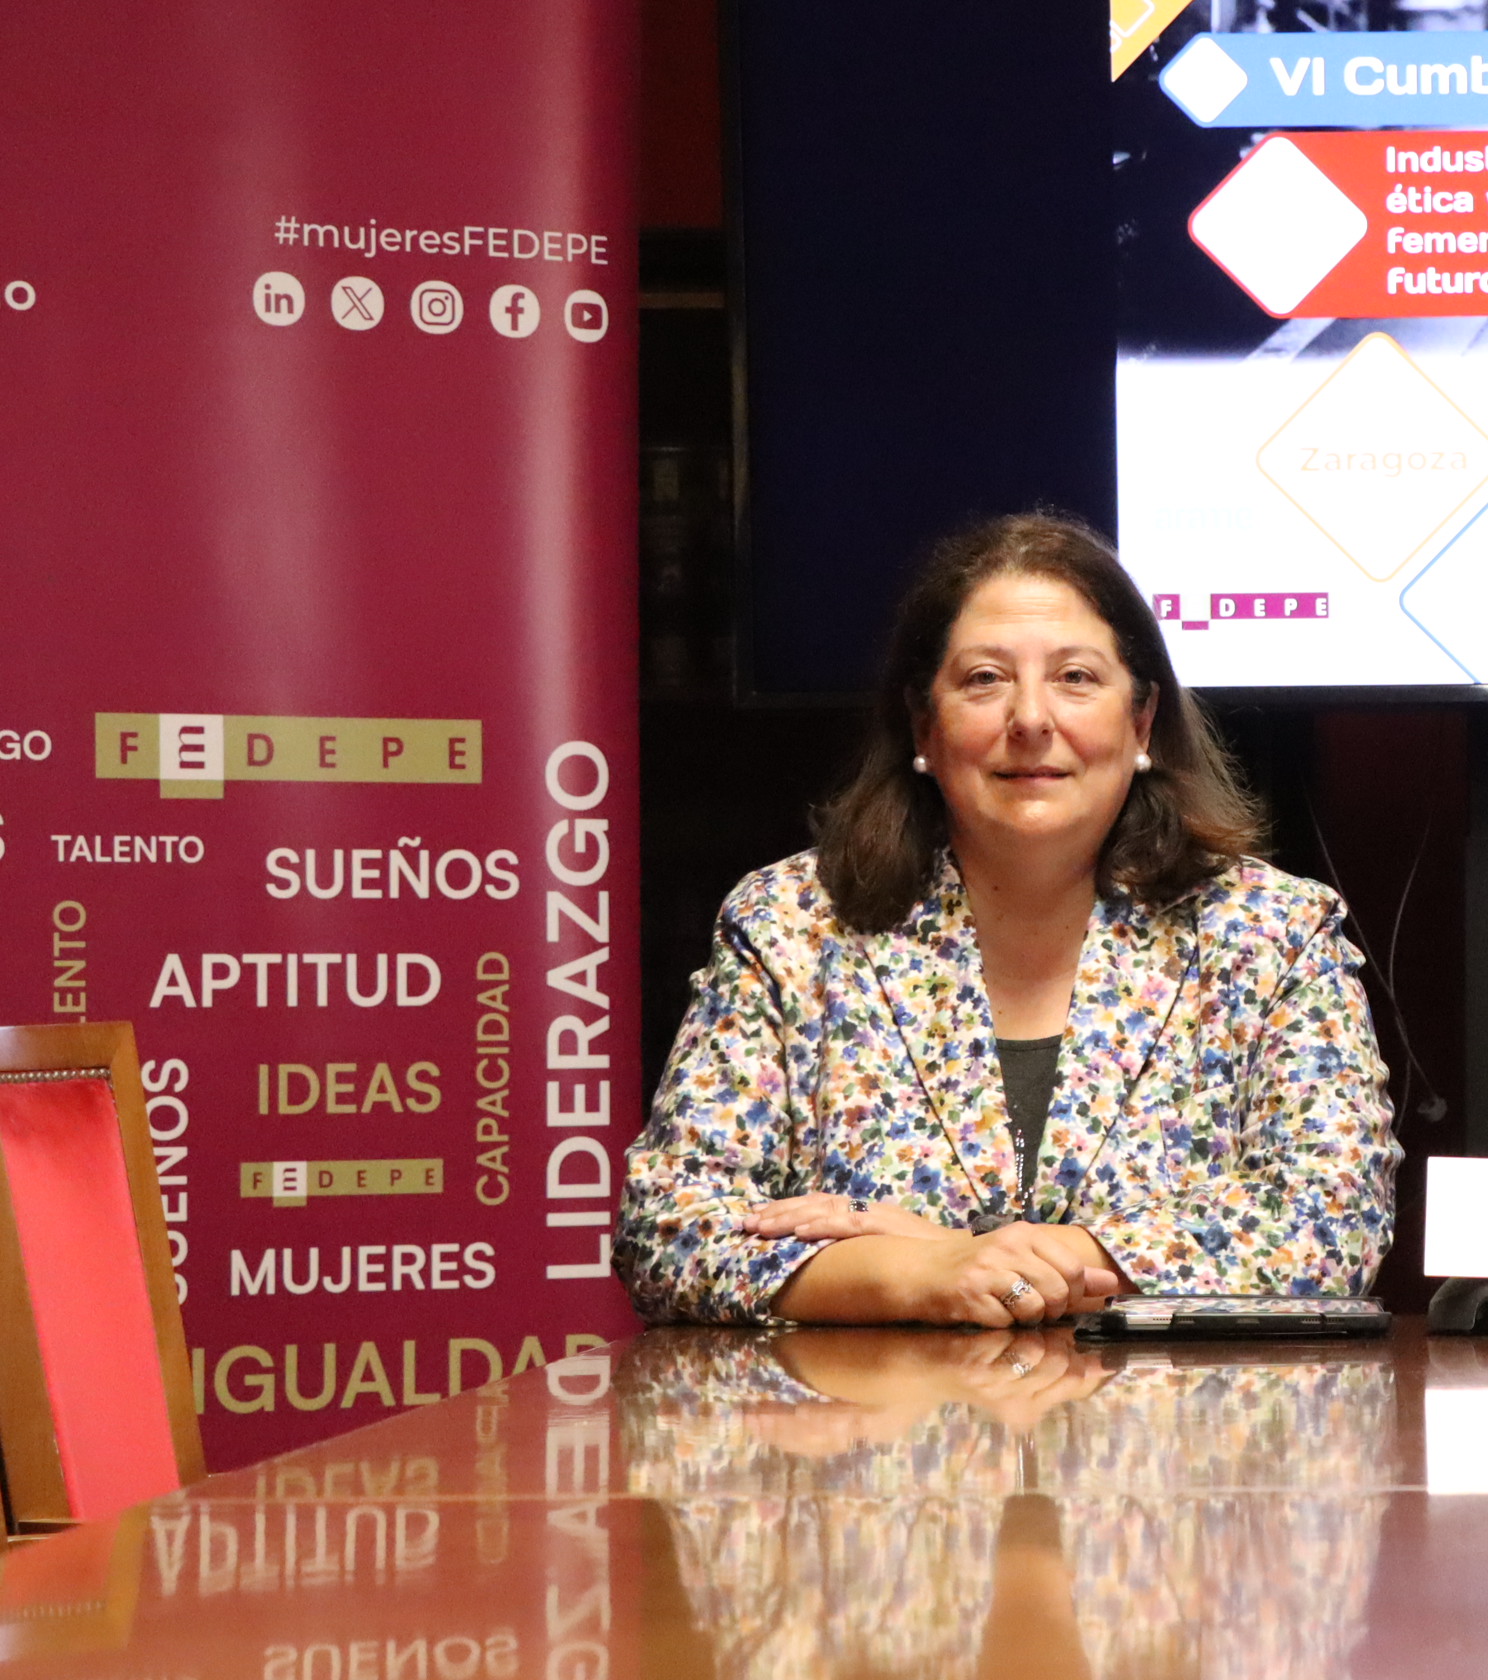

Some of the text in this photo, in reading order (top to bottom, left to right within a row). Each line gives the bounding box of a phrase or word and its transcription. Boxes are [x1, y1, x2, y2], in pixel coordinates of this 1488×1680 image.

[1269, 56, 1326, 97] VI
[1386, 183, 1474, 214] ética
[274, 215, 608, 265] #mujeresFEDEPE
[1300, 447, 1468, 478] Zaragoza
[1160, 597, 1328, 618] FDEPE
[50, 834, 205, 864] TALENTO
[265, 836, 520, 900] SUEÑOS
[52, 900, 87, 1023] ENTO
[149, 953, 442, 1008] APTITUD
[545, 740, 611, 1280] LIDERAZGO
[258, 1061, 442, 1115] IDEAS
[475, 951, 510, 1206] CAPACIDAD
[230, 1241, 496, 1296] MUJERES
